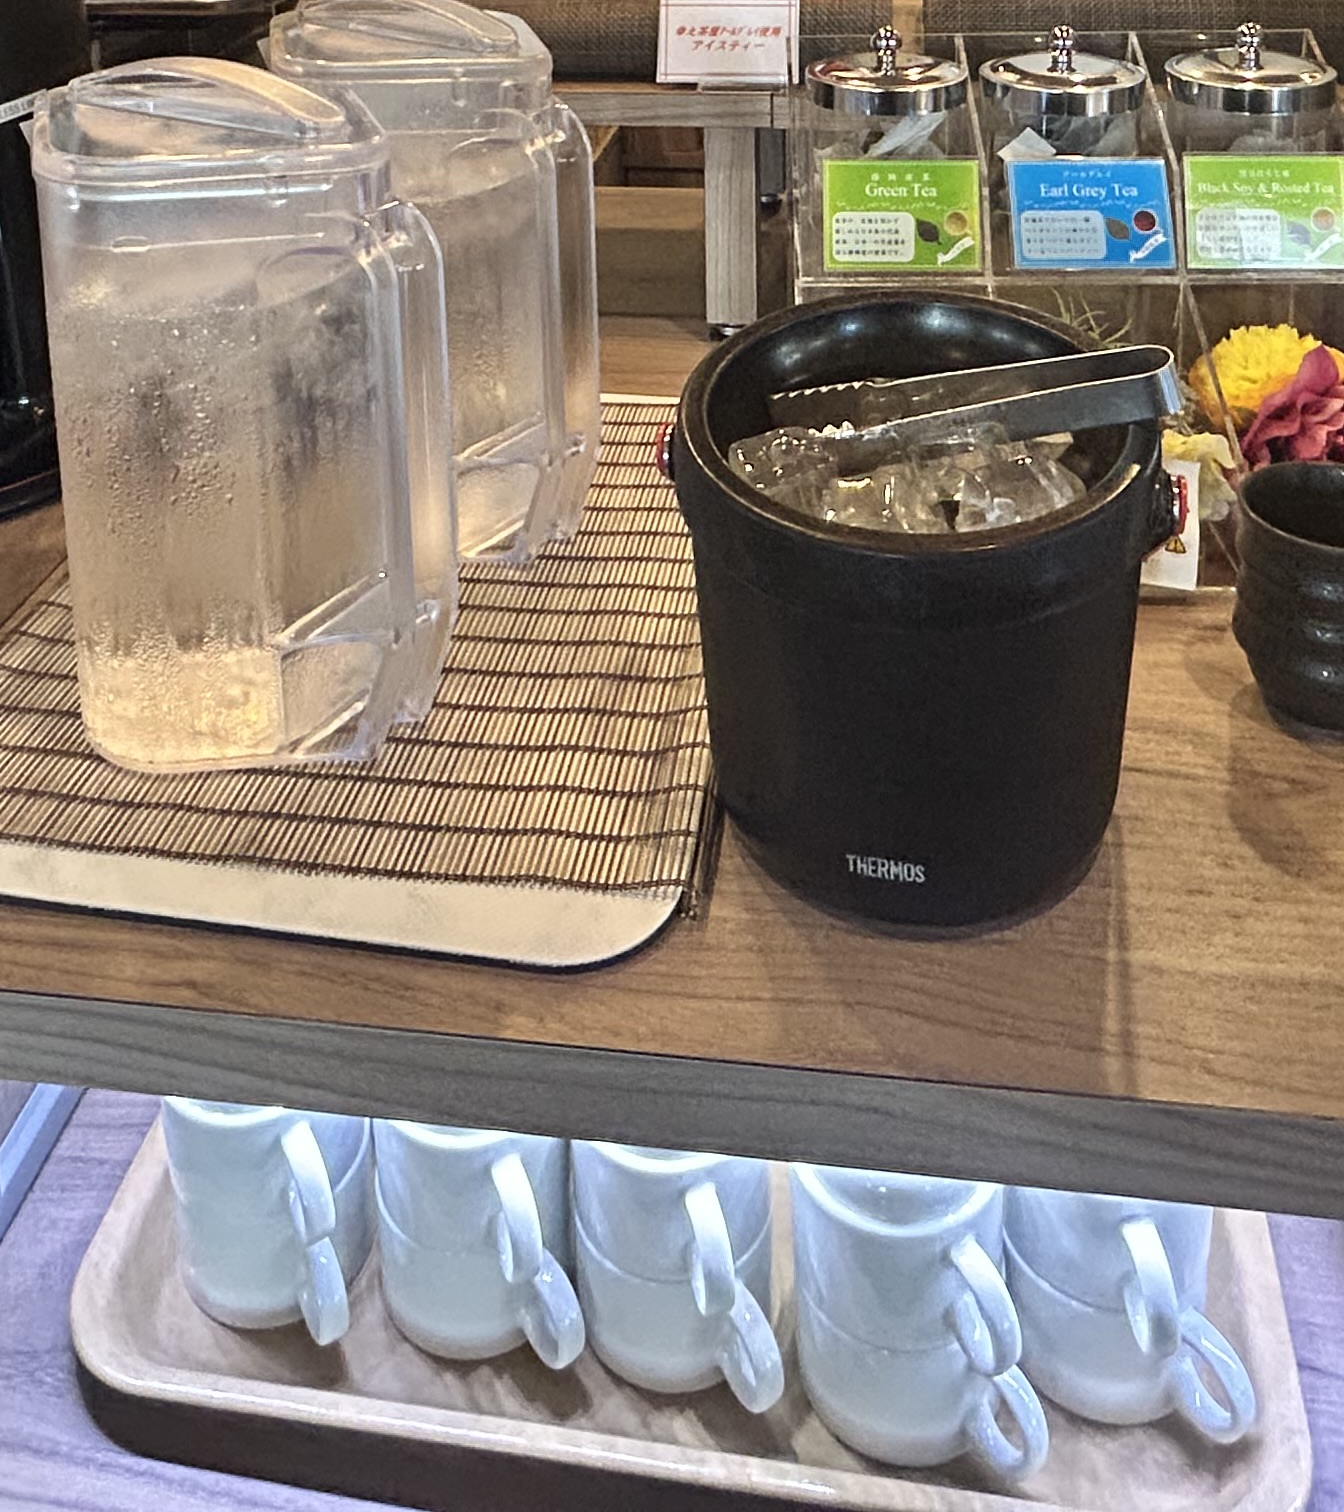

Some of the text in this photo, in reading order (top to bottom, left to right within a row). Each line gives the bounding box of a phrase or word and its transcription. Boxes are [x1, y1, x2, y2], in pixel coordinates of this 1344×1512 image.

[691, 40, 766, 52] アイスティー
[864, 183, 938, 197] Green Tea
[1039, 183, 1139, 200] Earl Grey Tea
[846, 854, 925, 883] THERMOS
